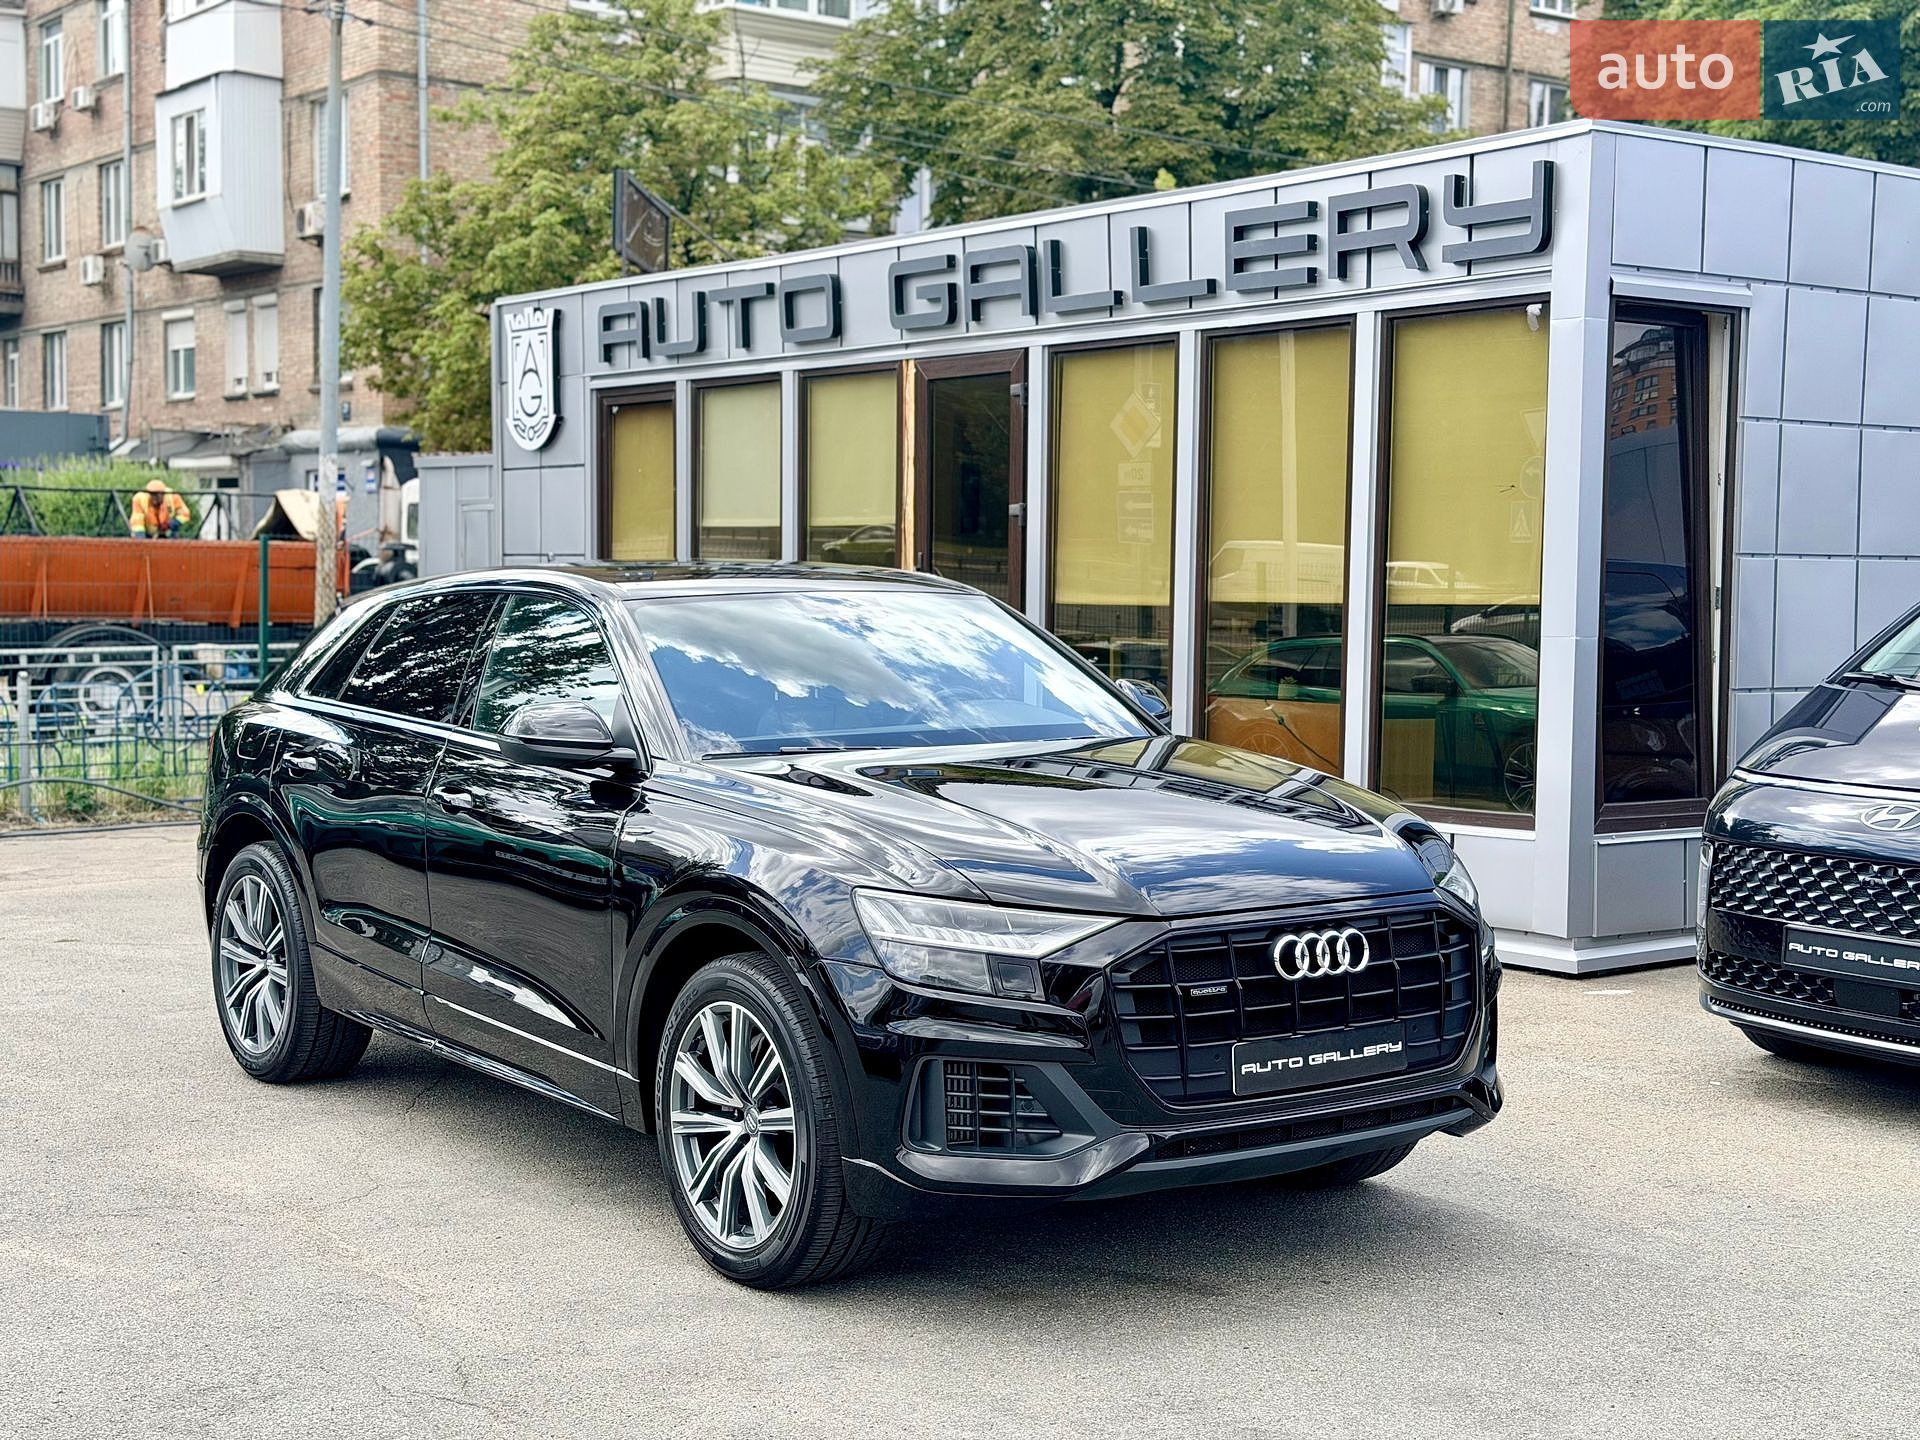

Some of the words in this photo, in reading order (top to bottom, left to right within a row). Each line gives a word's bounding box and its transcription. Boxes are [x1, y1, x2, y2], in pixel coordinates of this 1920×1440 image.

[598, 274, 842, 363] AUTO
[888, 160, 1554, 329] GALLERY
[1788, 942, 1838, 958] AUTO
[1842, 951, 1920, 971] GALLER
[1241, 1057, 1303, 1075] AUTO
[1308, 1041, 1402, 1065] GALLERY
